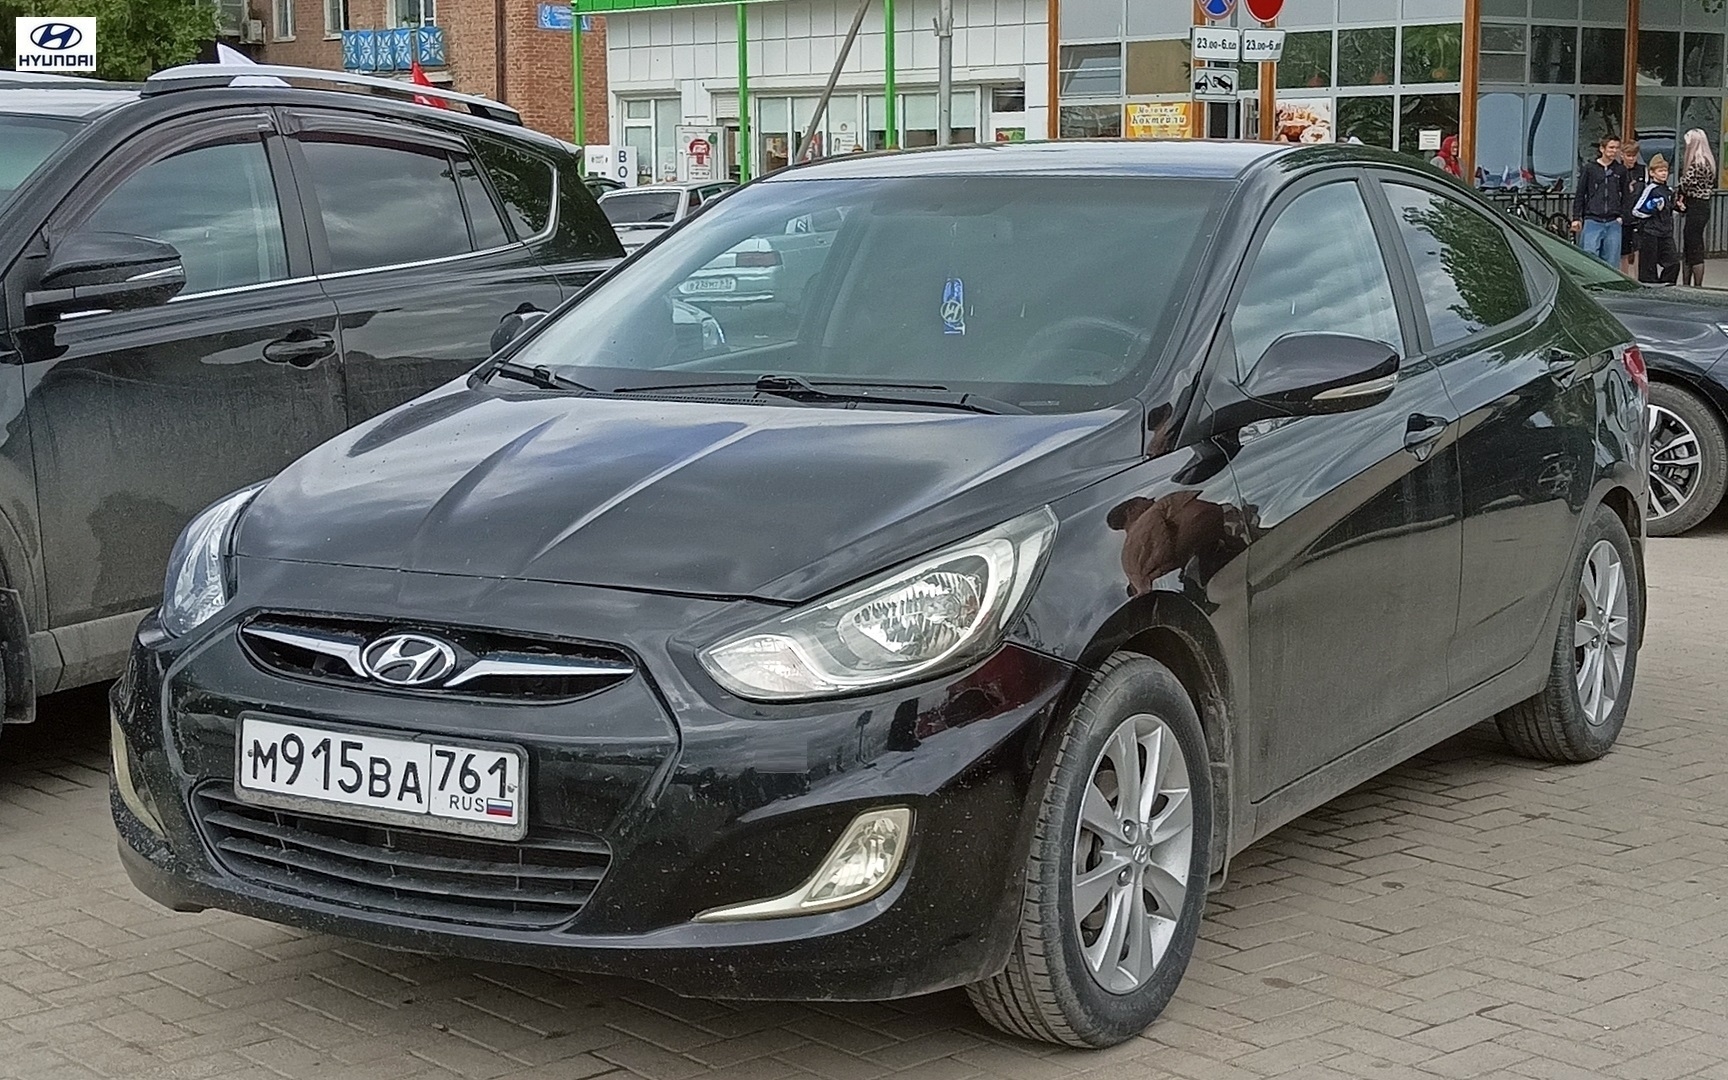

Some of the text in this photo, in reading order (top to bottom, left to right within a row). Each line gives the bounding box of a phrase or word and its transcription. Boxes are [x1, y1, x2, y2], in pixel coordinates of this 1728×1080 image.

[252, 733, 508, 804] М915ВА 761
[449, 794, 485, 813] RUS
